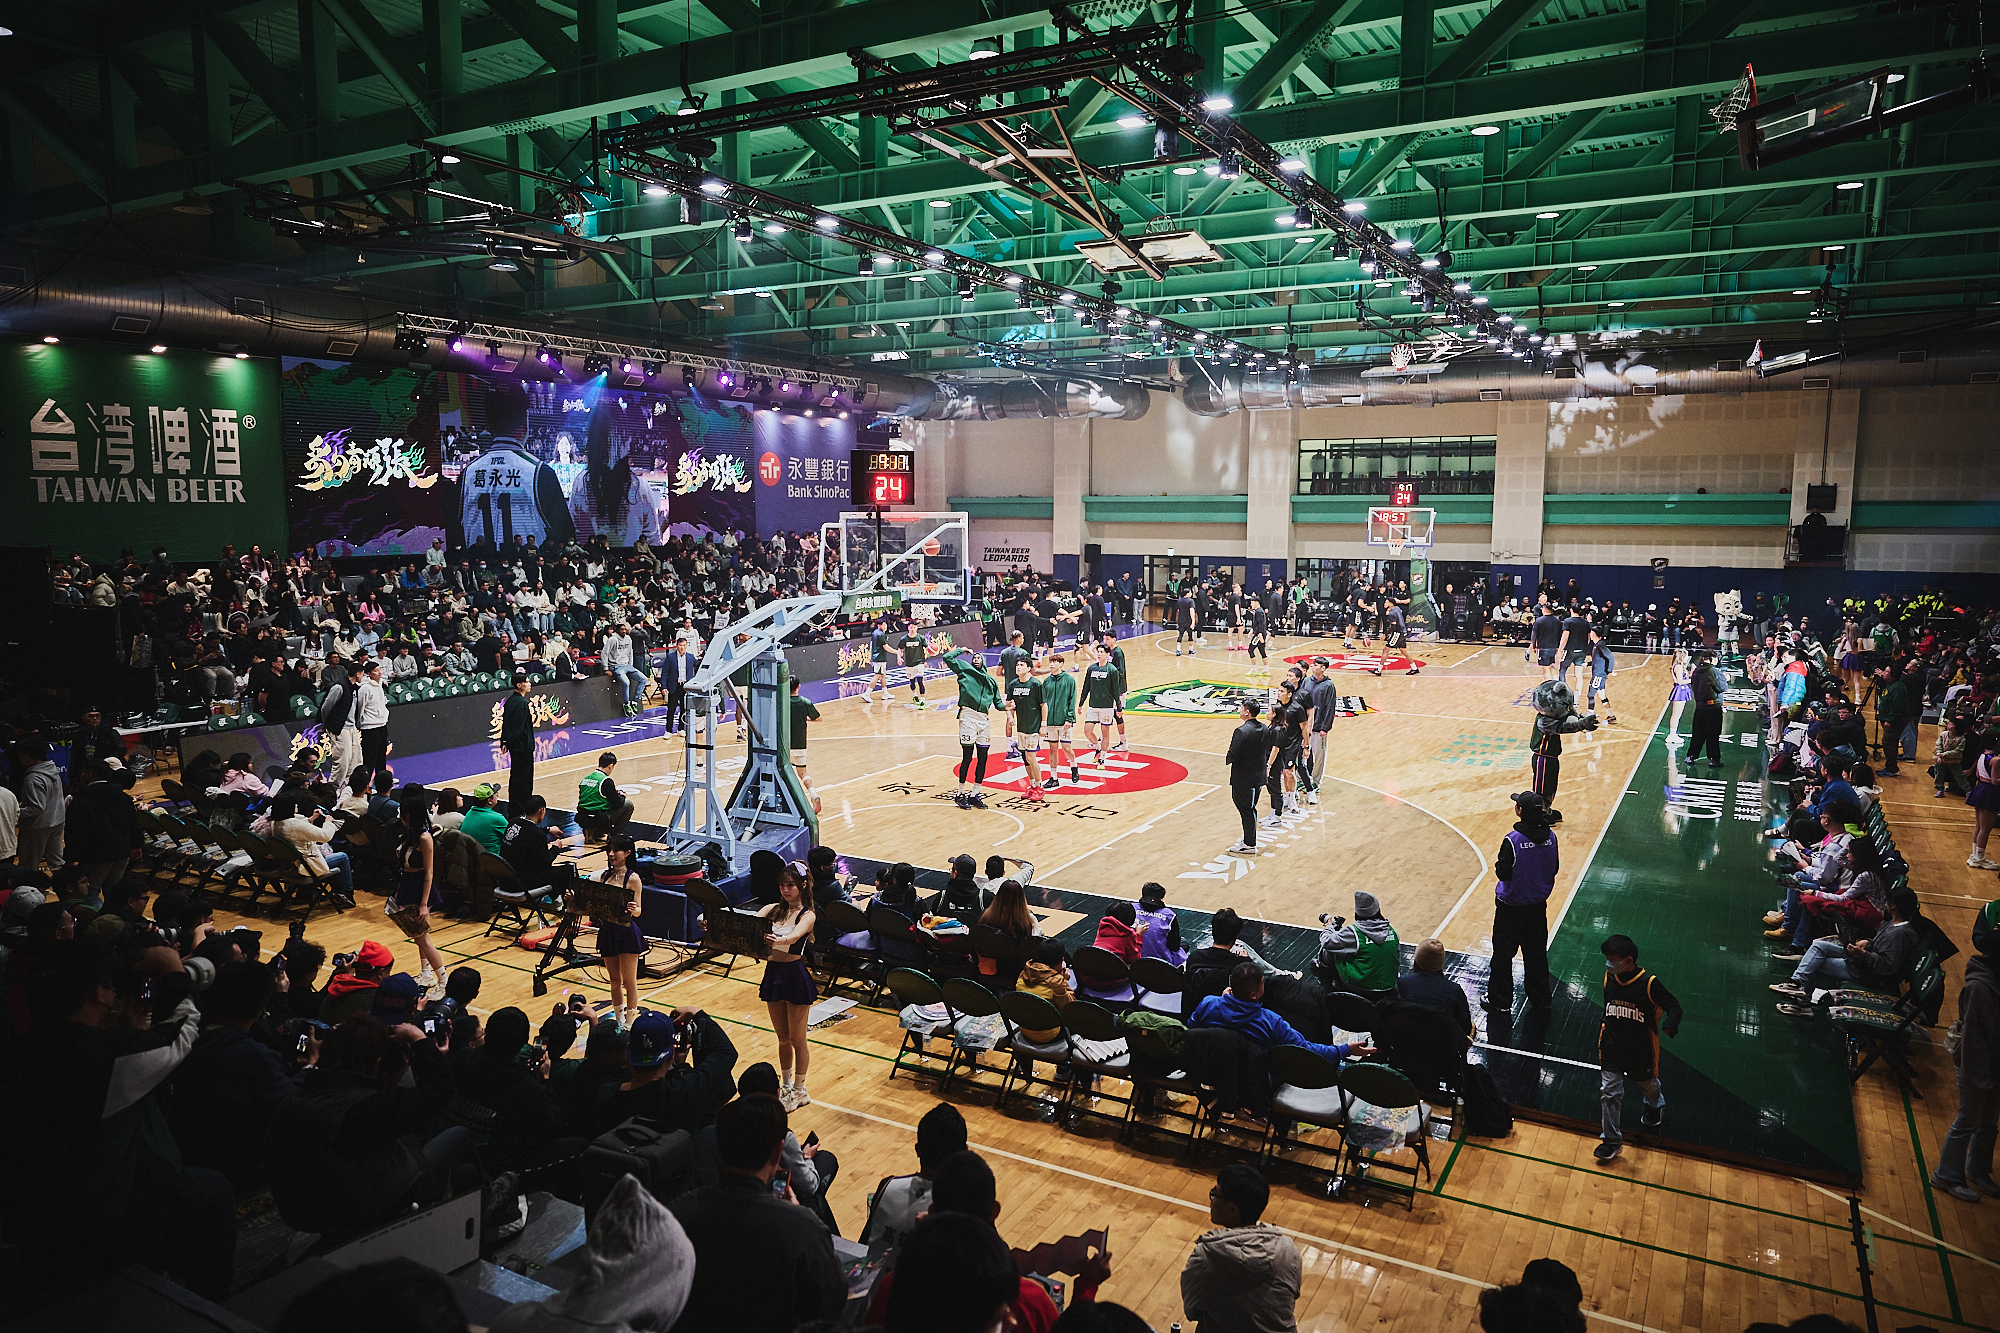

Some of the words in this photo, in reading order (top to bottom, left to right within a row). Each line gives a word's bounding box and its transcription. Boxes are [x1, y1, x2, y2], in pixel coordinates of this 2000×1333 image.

[473, 468, 521, 488] 葛永光
[788, 457, 849, 482] 永豐銀行
[30, 476, 156, 502] TAIWAN
[167, 478, 246, 503] BEER
[788, 485, 812, 498] Bank
[814, 485, 850, 499] SinoPac
[875, 475, 902, 501] 24
[1396, 492, 1411, 504] 24
[1379, 512, 1406, 522] 18:57
[983, 554, 1030, 563] LEOPARDS
